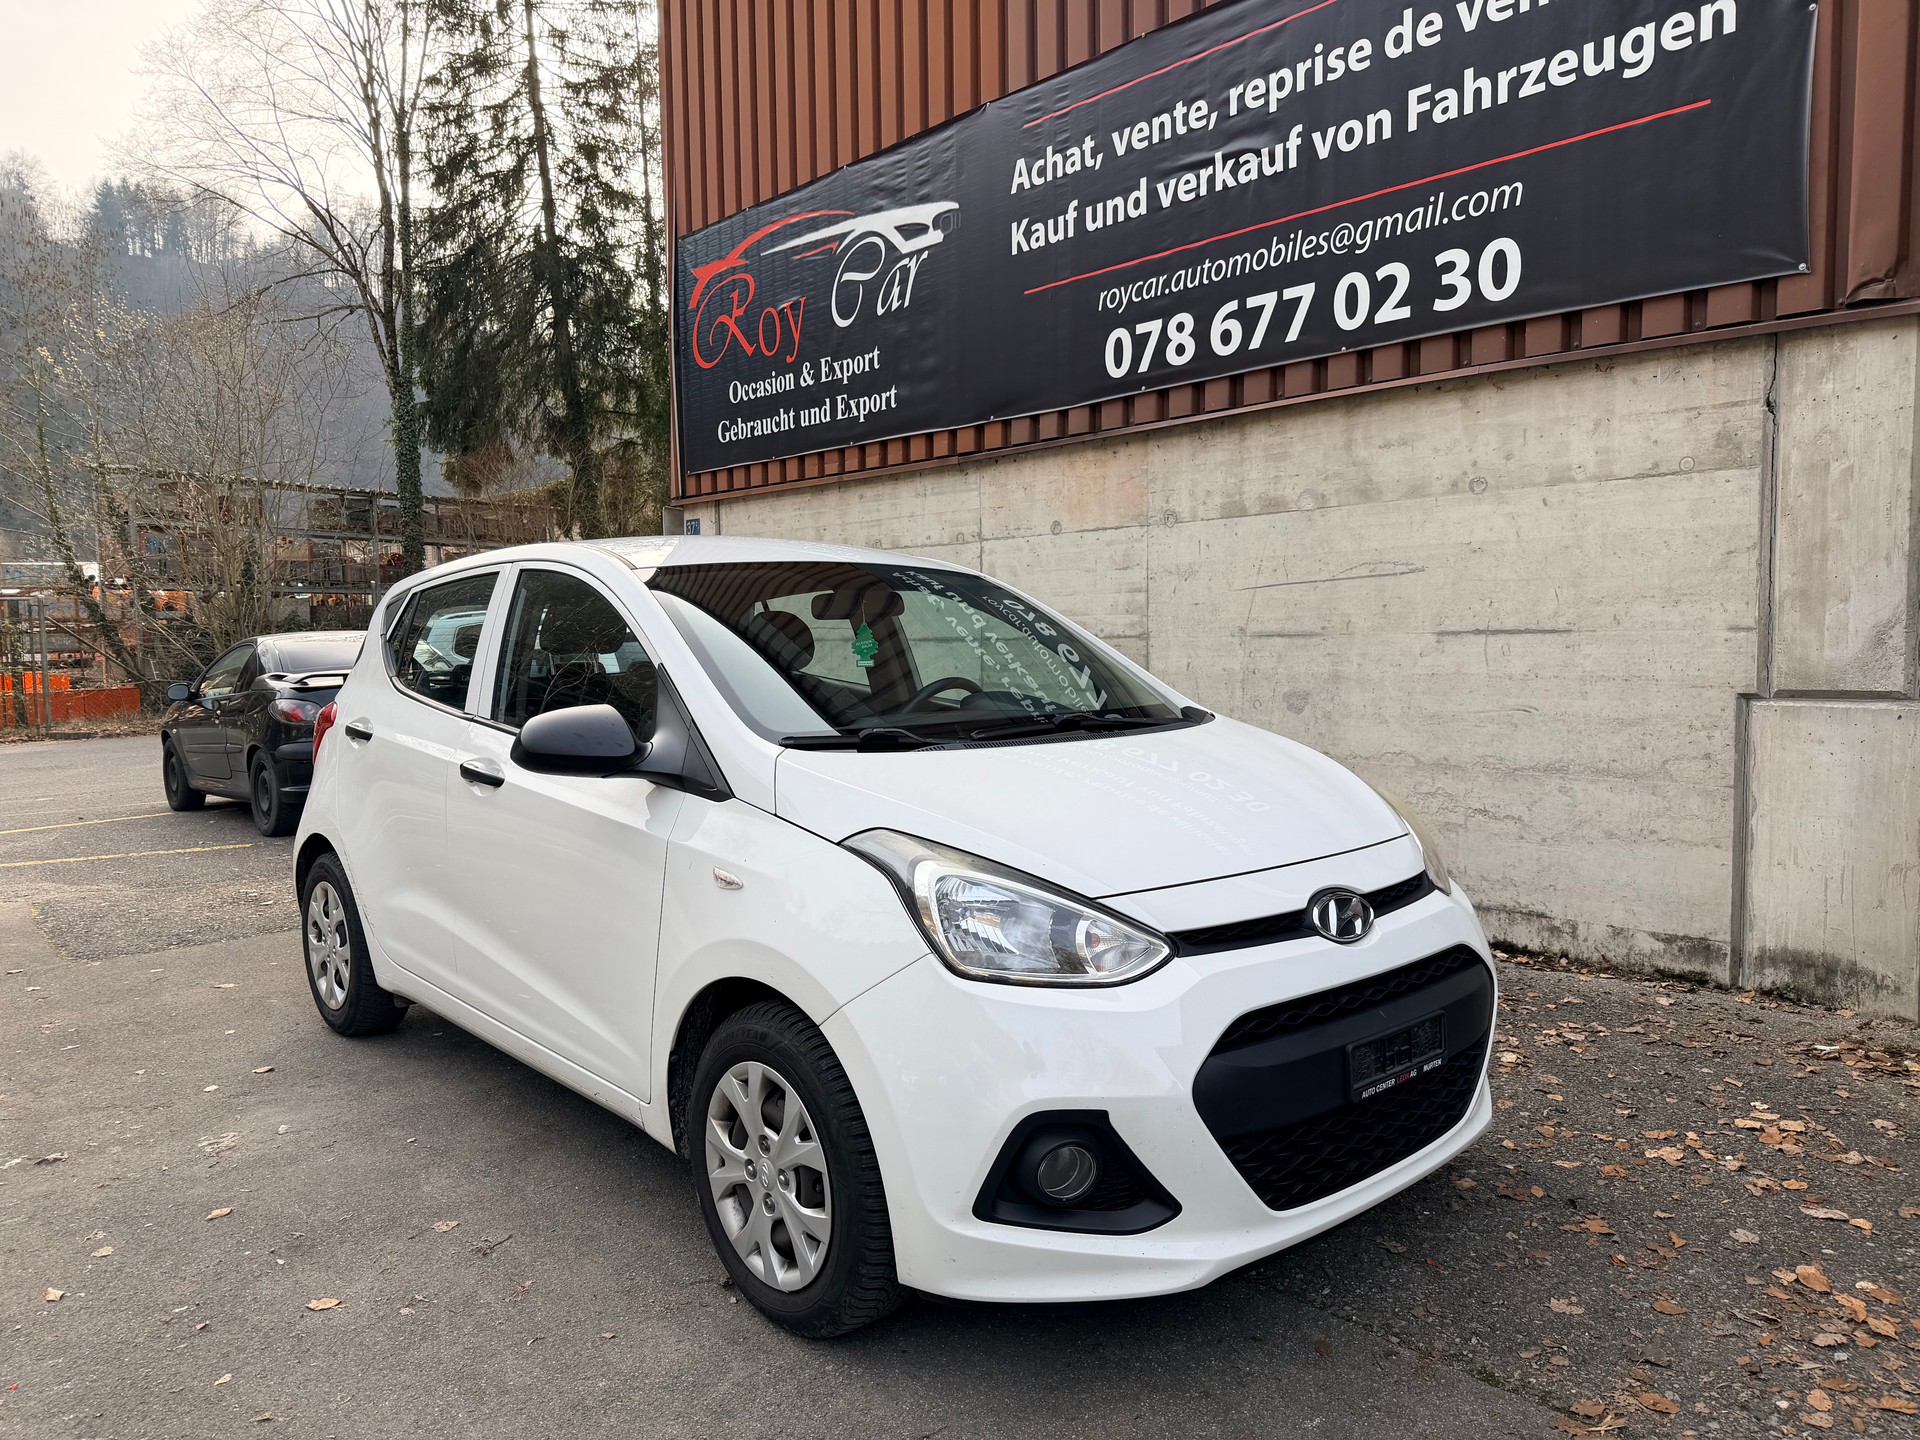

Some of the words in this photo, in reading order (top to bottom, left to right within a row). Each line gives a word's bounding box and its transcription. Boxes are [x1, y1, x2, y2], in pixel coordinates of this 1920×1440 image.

[1010, 135, 1104, 195] Achat,
[1112, 99, 1218, 157] vente,
[1229, 37, 1373, 118] reprise
[1385, 8, 1443, 60] de
[1010, 199, 1079, 256] Kauf
[1085, 177, 1148, 232] und
[1156, 124, 1303, 209] verkauf
[1311, 108, 1392, 161] von
[1407, 0, 1737, 133] Fahrzeugen
[692, 272, 807, 369] Roy
[831, 236, 929, 328] Car
[1098, 181, 1524, 314] roycar.automobiles@gmail.com
[1104, 311, 1197, 379] 078
[1210, 282, 1317, 357] 677
[1333, 261, 1412, 332] 02
[1432, 237, 1523, 312] 30
[717, 407, 796, 443] Gebraucht
[800, 398, 830, 427] und
[835, 384, 898, 422] Export
[729, 370, 795, 404] Occasion
[800, 361, 815, 387] &
[820, 345, 881, 384] Export
[1361, 1086, 1376, 1099] AUTO
[1376, 1078, 1396, 1092] CENTER
[1410, 1069, 1418, 1079] AG
